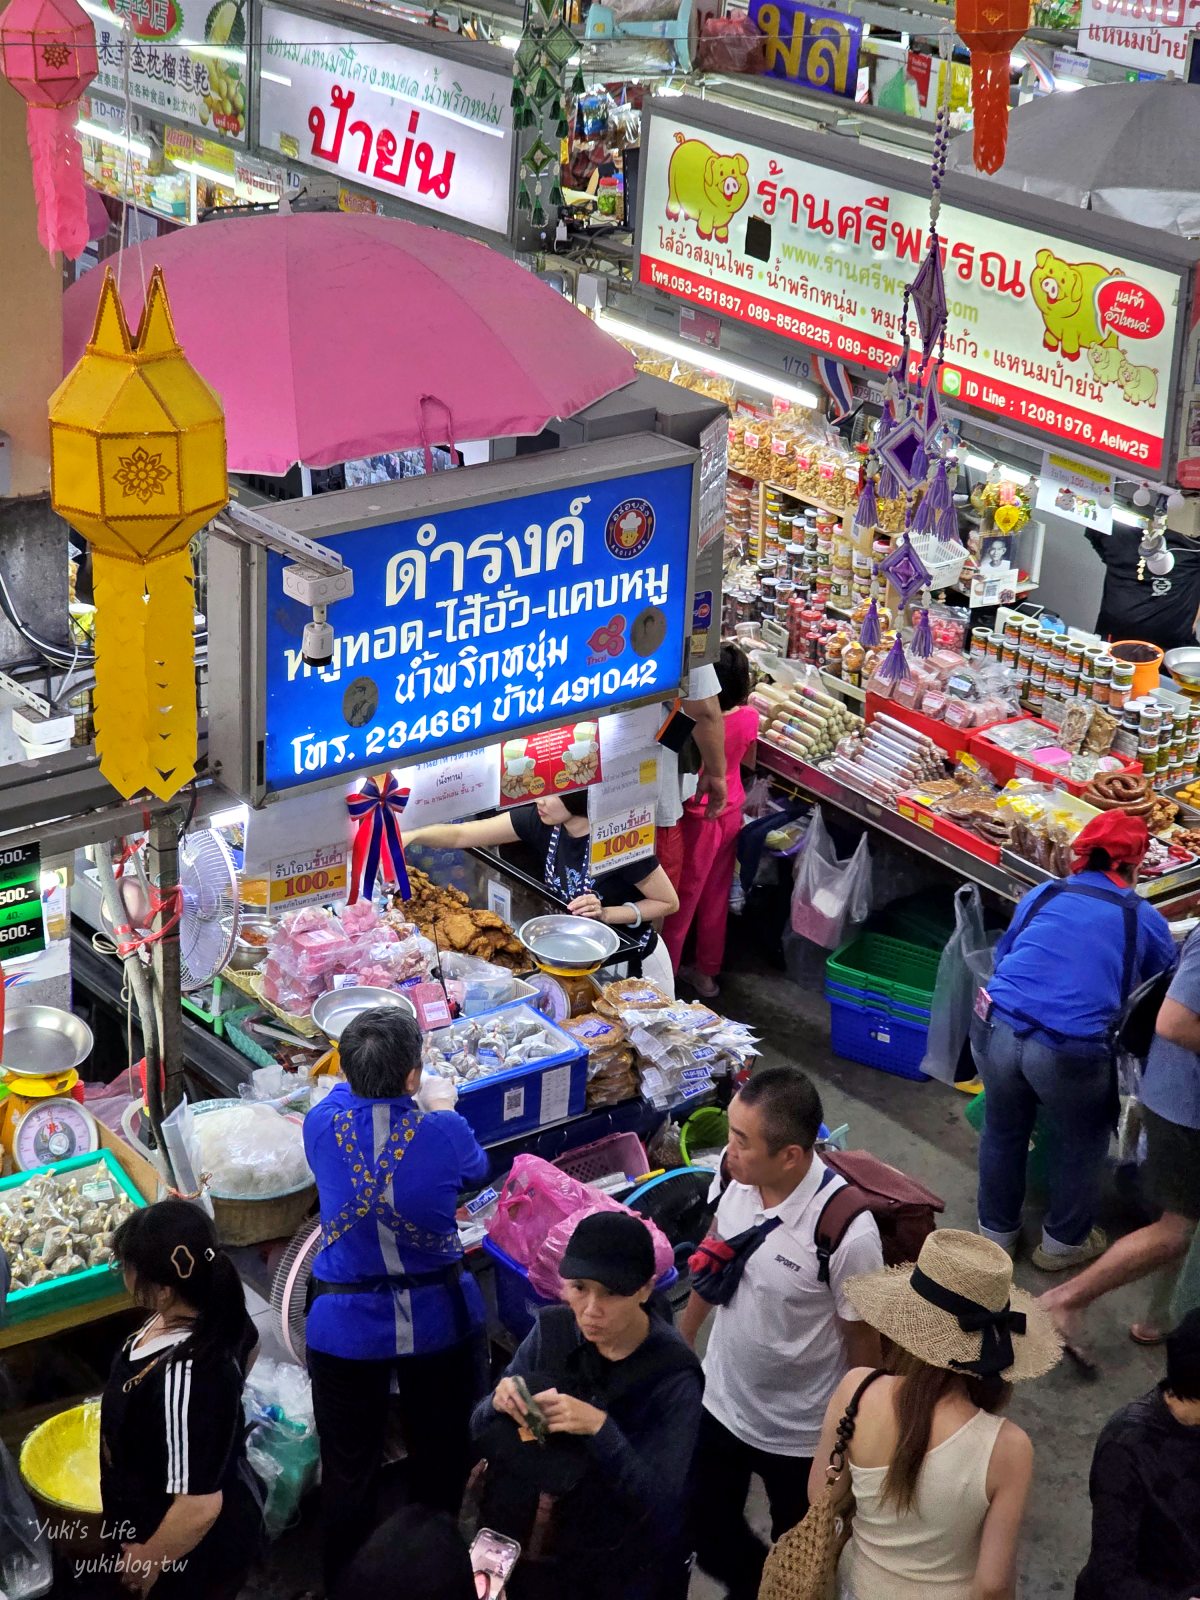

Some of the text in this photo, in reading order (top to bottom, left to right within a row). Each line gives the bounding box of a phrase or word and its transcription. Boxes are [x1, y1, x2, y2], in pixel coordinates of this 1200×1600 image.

[782, 355, 810, 378] 1/79
[966, 380, 979, 397] ID
[982, 385, 1006, 409] Line
[1099, 430, 1150, 460] Aelw25
[386, 495, 591, 607] ดำรงค์
[291, 731, 355, 775] โทร.
[365, 700, 482, 759] 234661
[493, 685, 545, 722] บ้าน
[550, 658, 658, 708] 491042
[603, 829, 650, 858] 100.-
[284, 870, 342, 898] 100.-
[774, 1254, 801, 1272] SPORTS
